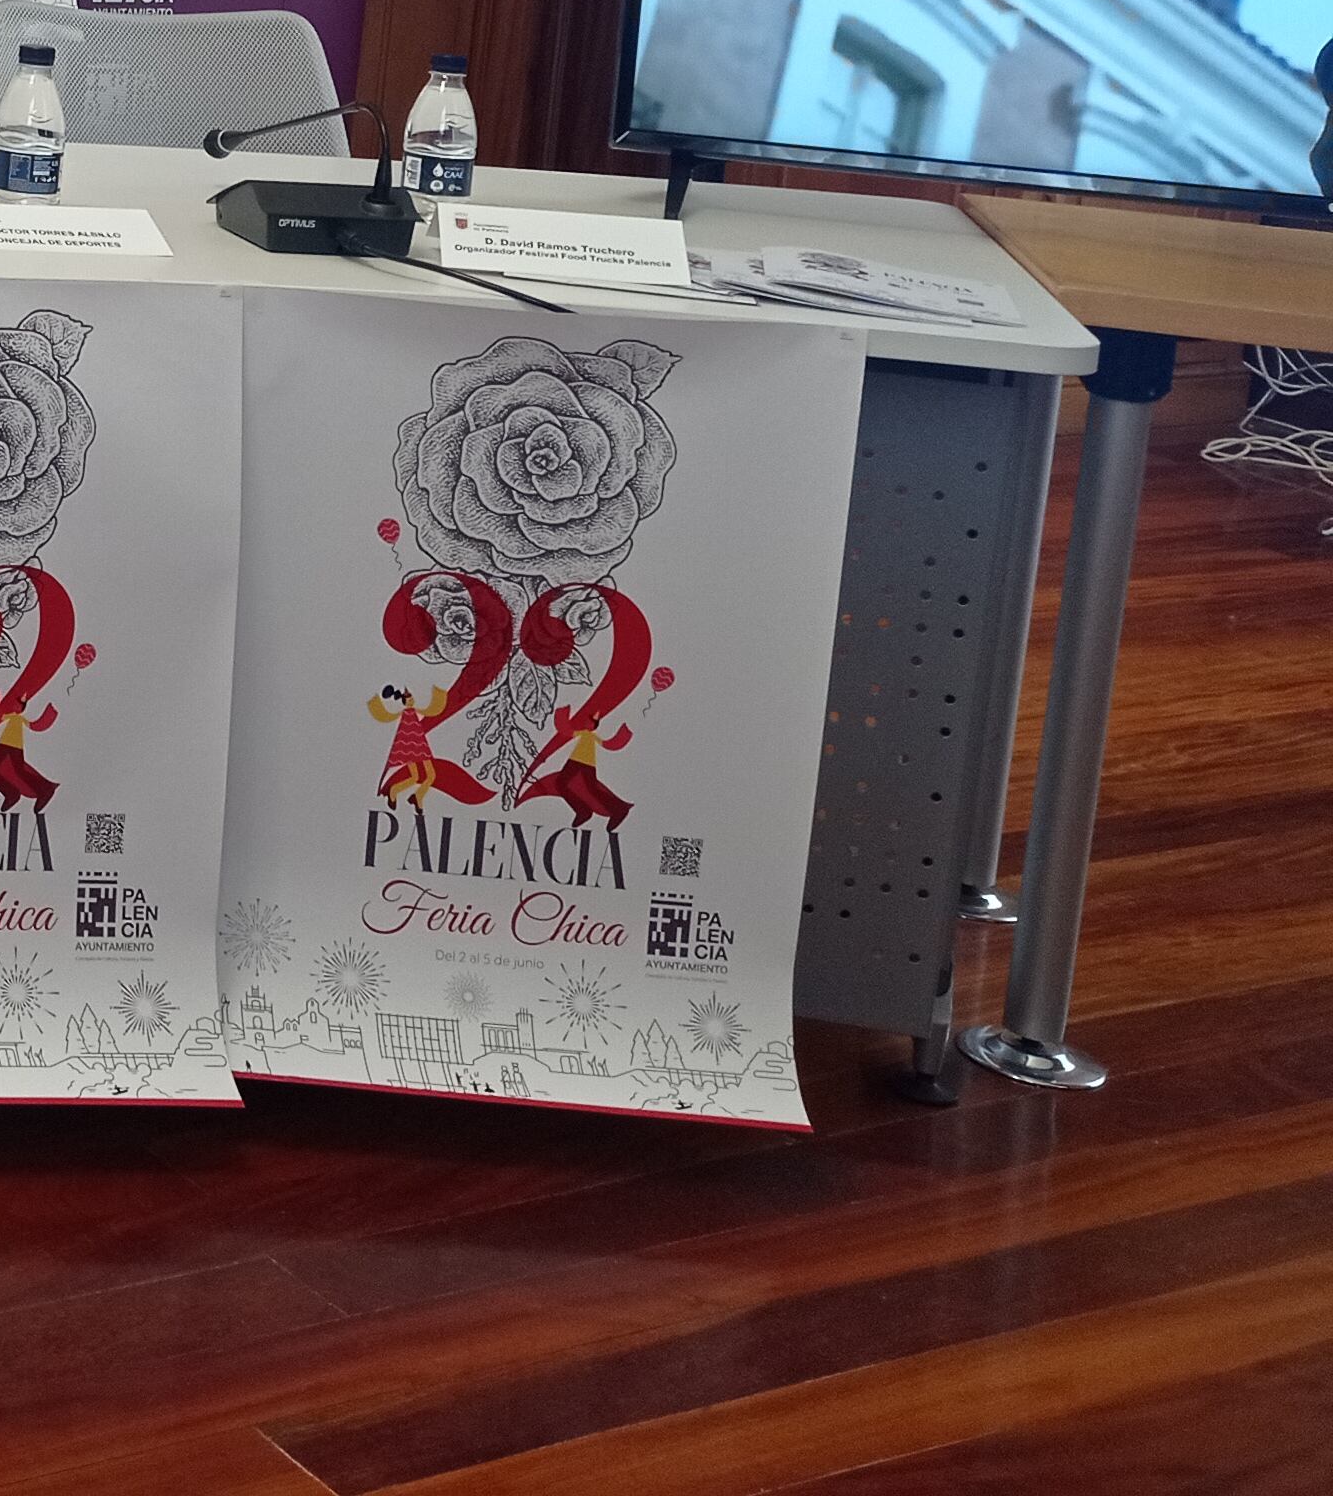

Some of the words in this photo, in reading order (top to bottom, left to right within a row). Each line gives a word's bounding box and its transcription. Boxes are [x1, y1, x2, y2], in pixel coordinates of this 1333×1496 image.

[454, 244, 516, 256] Organizador
[519, 249, 558, 259] Festival
[561, 252, 588, 261] Food
[590, 255, 625, 265] Trucks
[627, 258, 671, 268] Palencia
[500, 238, 534, 249] David
[537, 242, 578, 252] Ramos
[581, 244, 635, 257] Truchero
[377, 571, 652, 809] 22
[363, 809, 627, 890] PALENCIA
[122, 888, 146, 903] PA
[121, 905, 158, 921] LEN
[361, 879, 495, 935] Feria
[510, 889, 630, 947] Chica
[697, 911, 722, 928] PA
[121, 922, 153, 938] CIA
[695, 927, 735, 945] LEN
[75, 942, 154, 952] AYUNTAMIENTO
[694, 944, 728, 961] CIA
[645, 960, 728, 974] AYUNTAMIENTO
